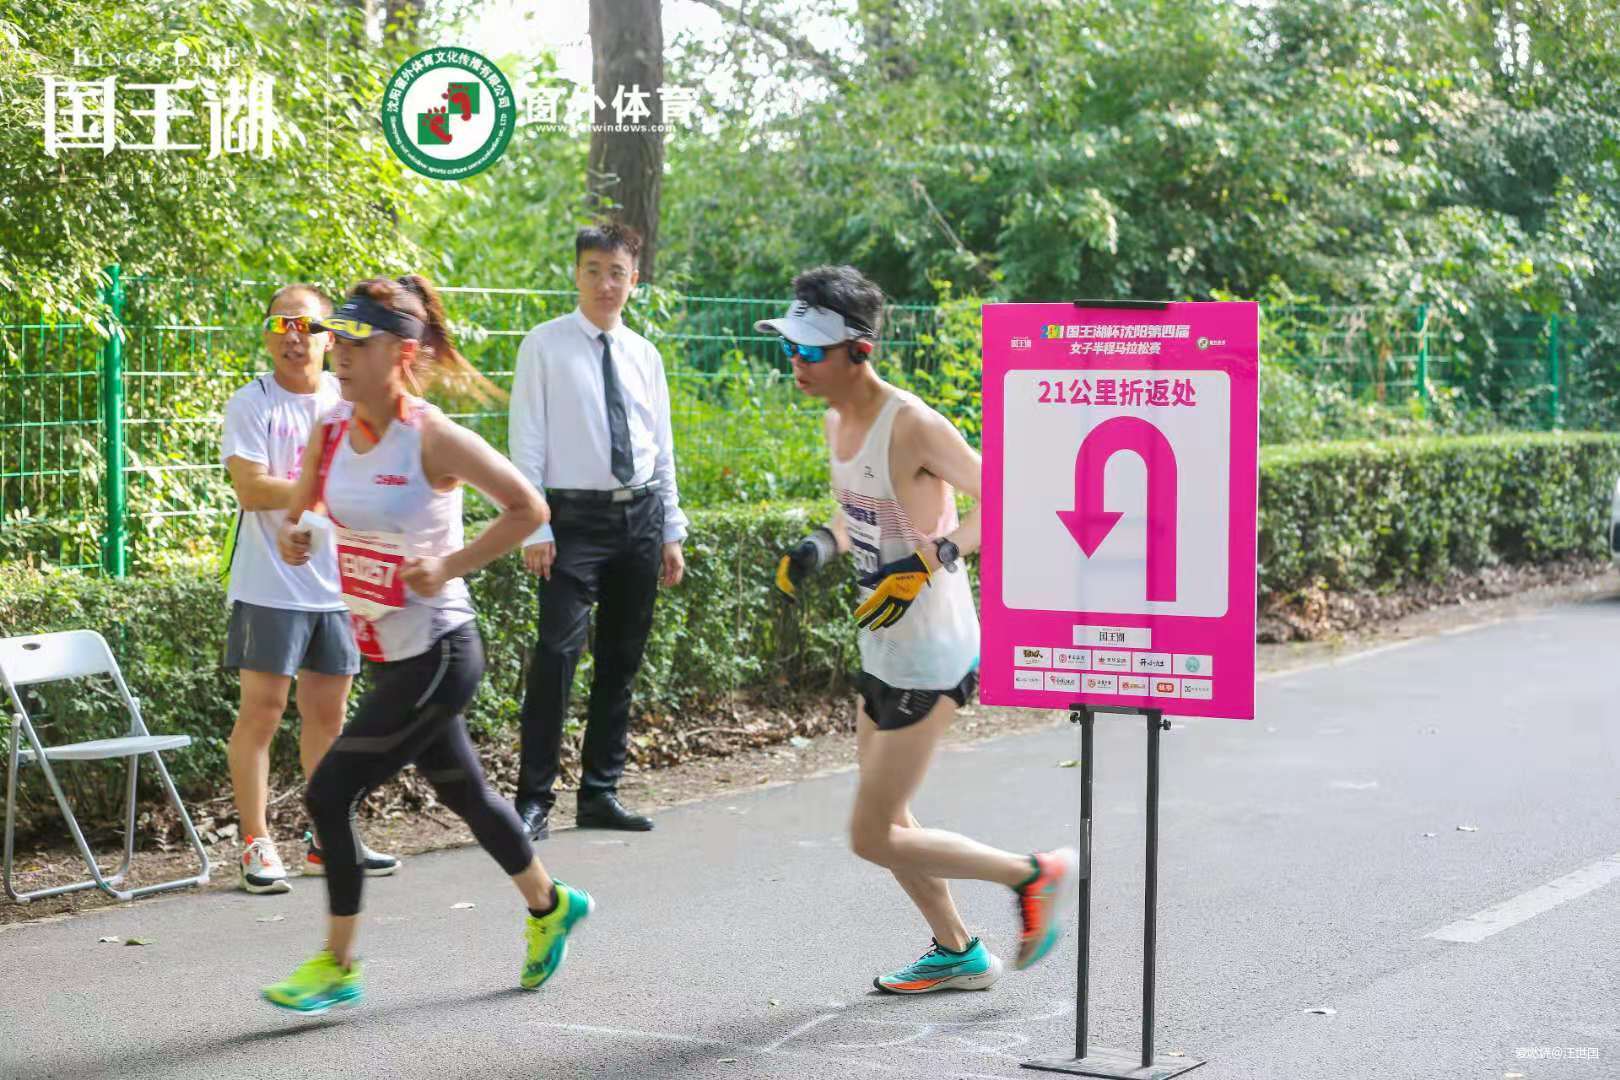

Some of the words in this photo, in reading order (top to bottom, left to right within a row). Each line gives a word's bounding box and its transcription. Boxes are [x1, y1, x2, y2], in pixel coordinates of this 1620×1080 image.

[1070, 342, 1161, 355] 女子半程马拉松赛
[1038, 378, 1197, 407] 21公里折返处
